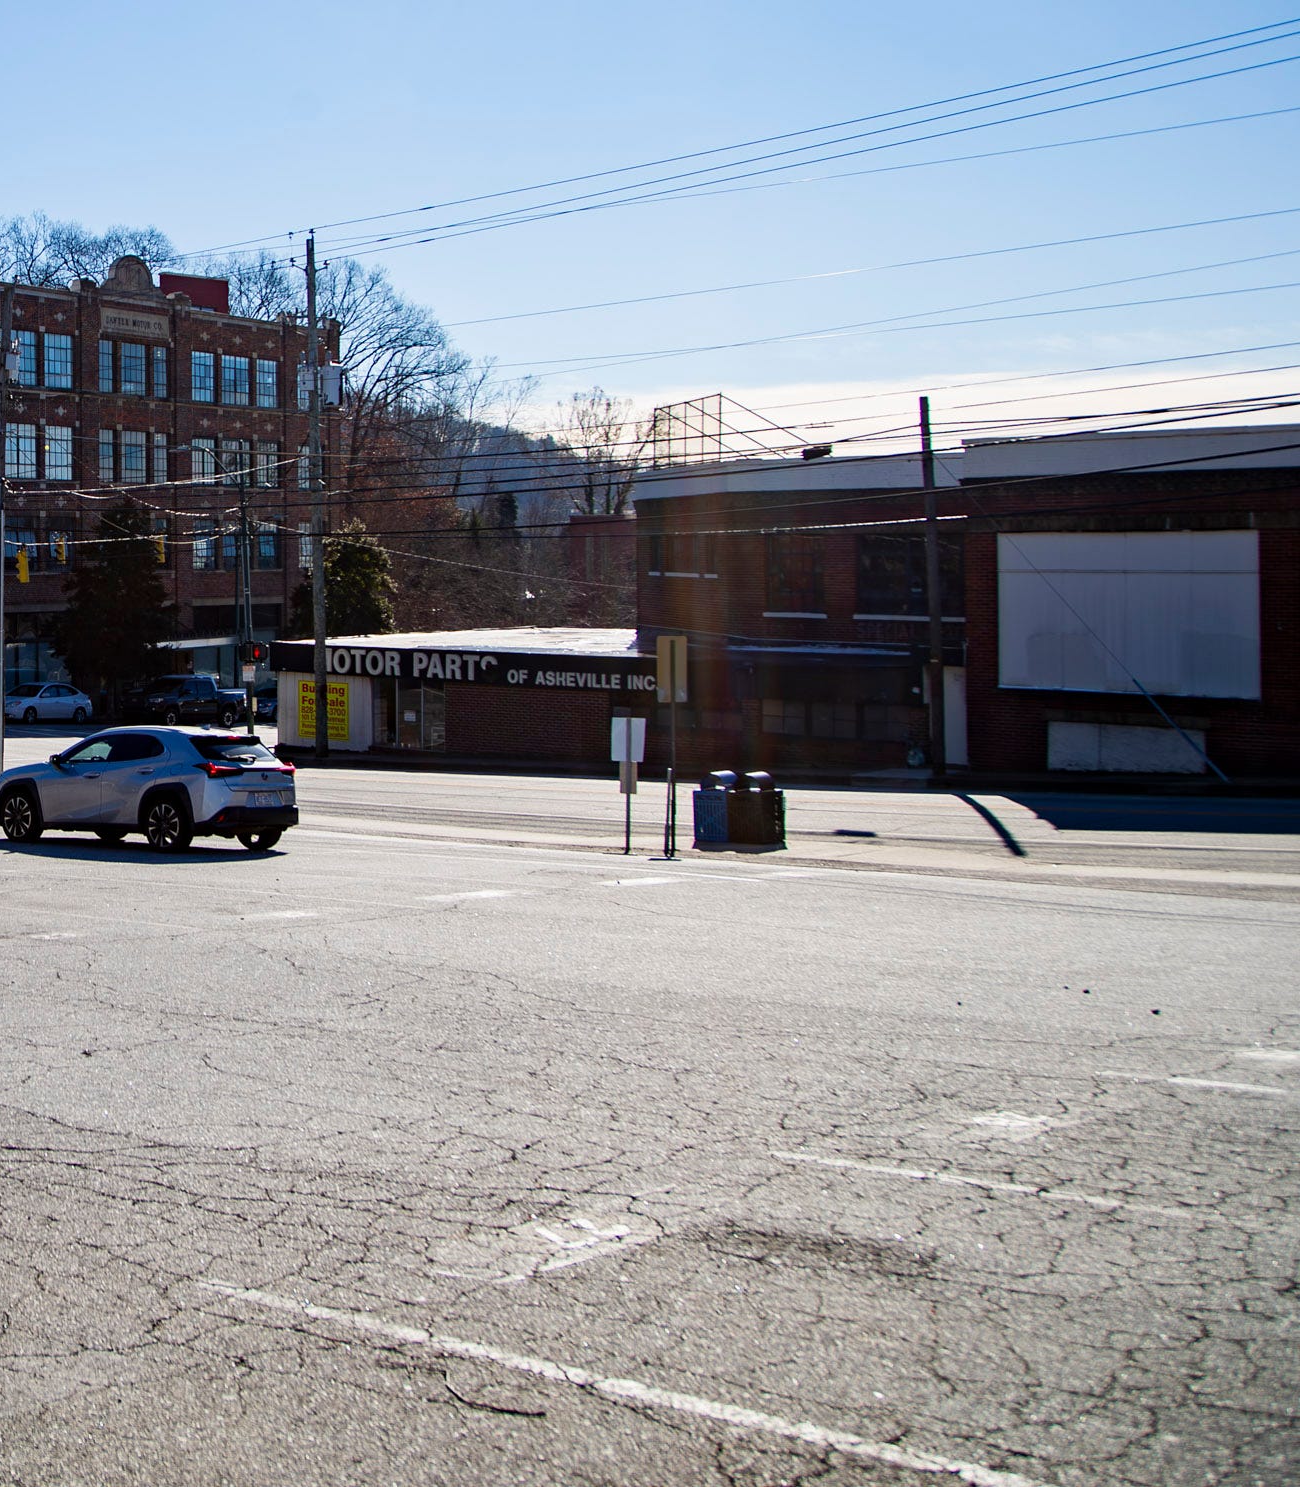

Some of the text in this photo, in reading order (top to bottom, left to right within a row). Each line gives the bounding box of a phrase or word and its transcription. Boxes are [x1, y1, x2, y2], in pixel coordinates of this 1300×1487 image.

[507, 669, 528, 684] OF
[535, 670, 620, 689] ASHEVILLE
[302, 683, 345, 697] Buing
[302, 695, 345, 707] Fo ale
